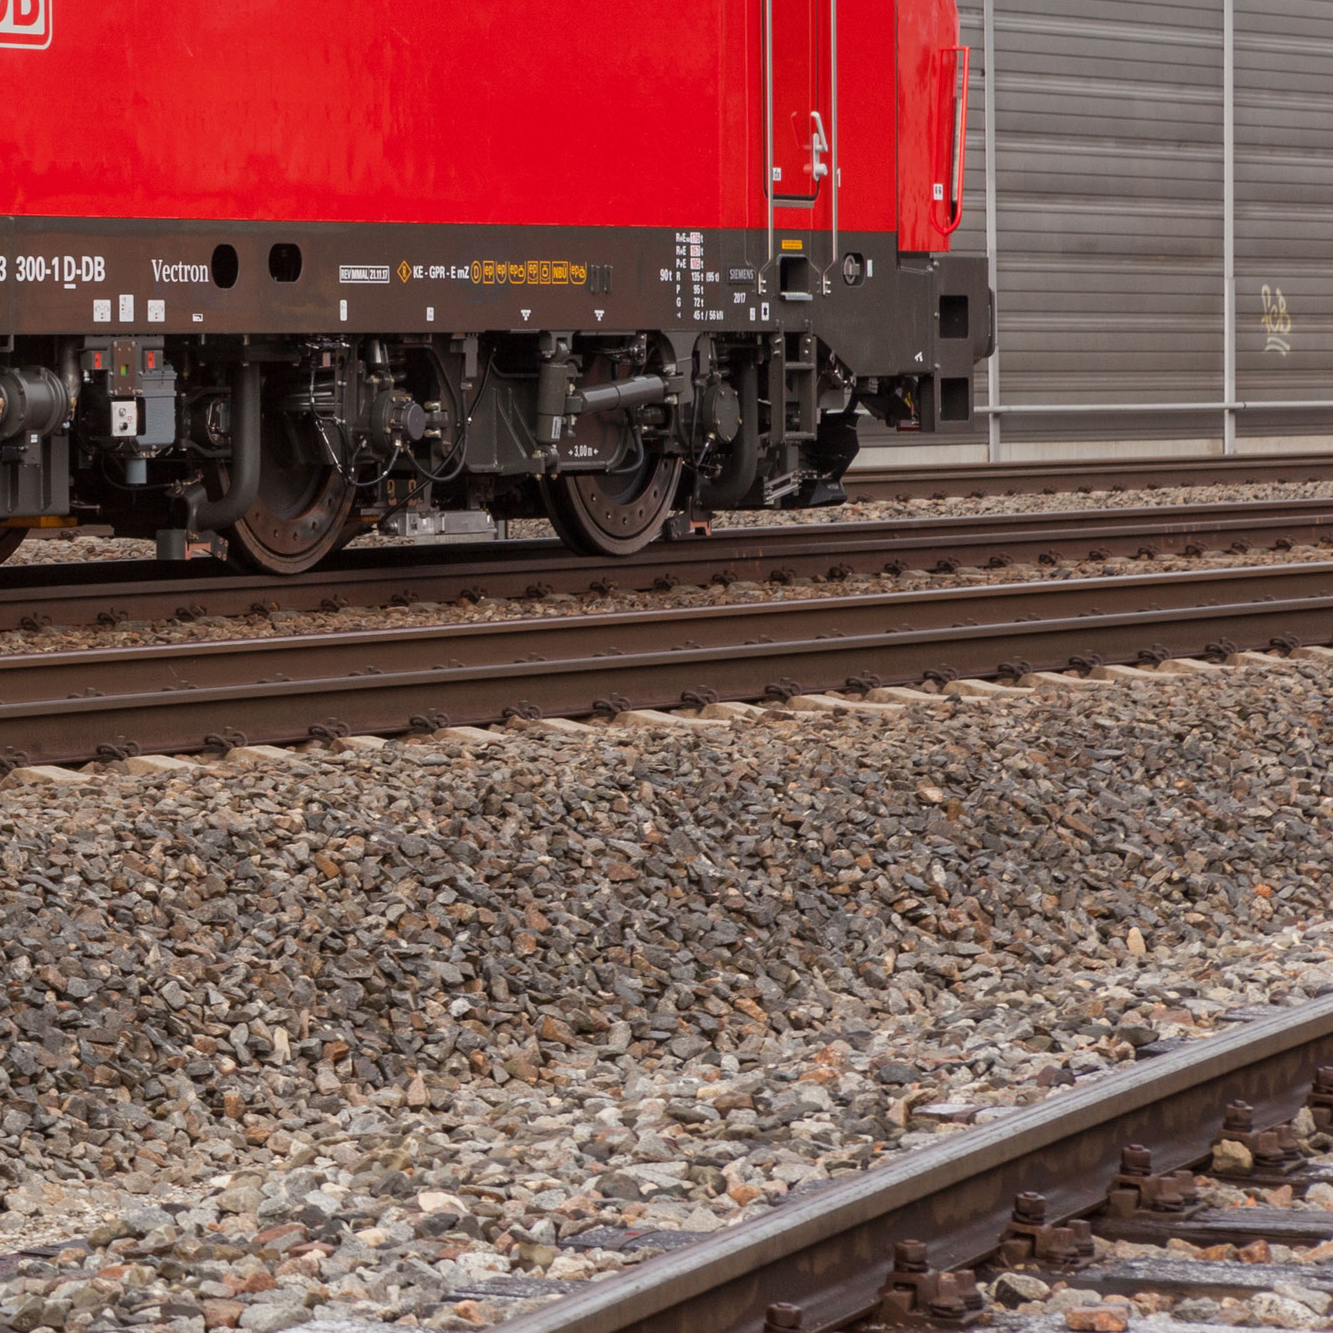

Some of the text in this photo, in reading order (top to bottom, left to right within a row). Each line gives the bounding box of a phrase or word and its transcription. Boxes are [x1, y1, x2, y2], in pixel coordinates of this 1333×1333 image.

[151, 259, 209, 282] Vectron
[413, 266, 423, 279] KE
[429, 266, 445, 279] GPR
[450, 266, 456, 279] E
[660, 268, 669, 281] 90
[729, 268, 754, 280] SIEMENS
[733, 292, 747, 304] 2017
